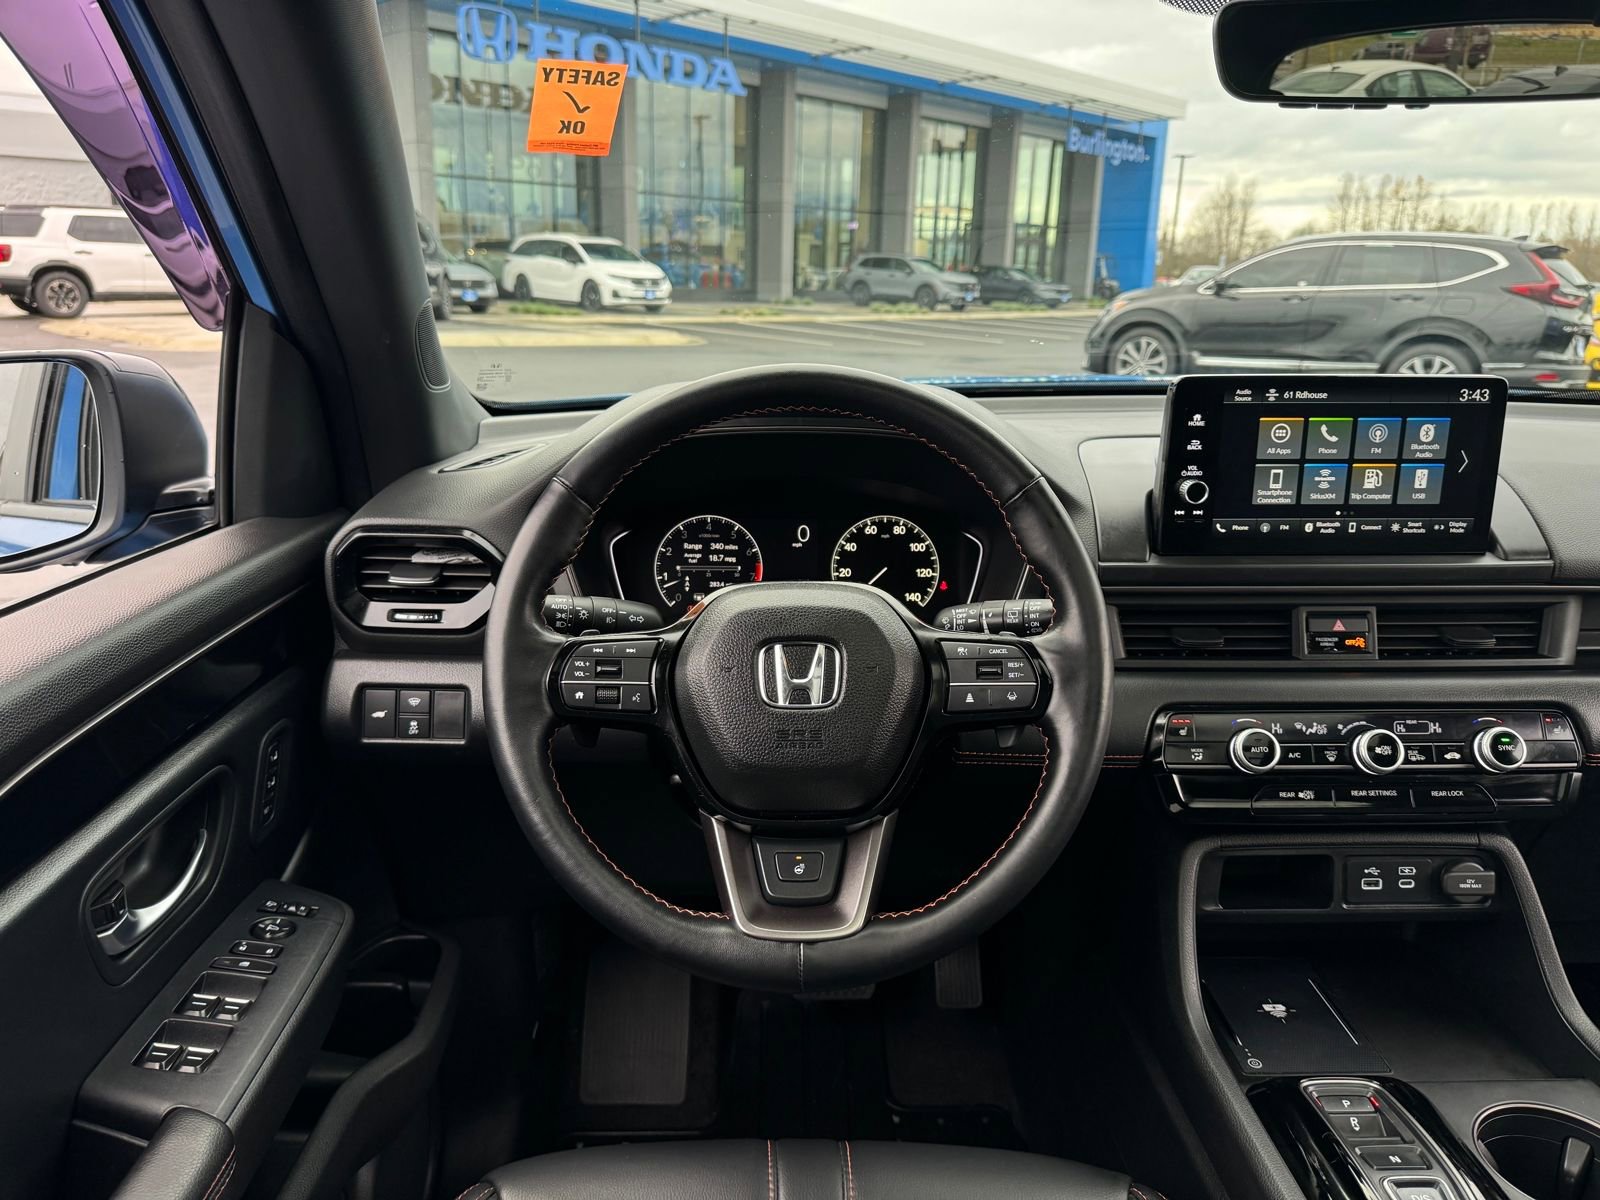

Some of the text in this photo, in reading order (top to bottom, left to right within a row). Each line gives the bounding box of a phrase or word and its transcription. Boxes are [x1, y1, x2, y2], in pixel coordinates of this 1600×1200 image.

[526, 22, 747, 96] HONDA
[1283, 391, 1328, 399] 61 Rdhouse
[1459, 388, 1490, 402] 3:43
[798, 524, 810, 542] 0
[864, 526, 877, 534] 60
[893, 526, 906, 534] 80
[731, 531, 736, 539] 5
[844, 542, 857, 552] 40
[909, 543, 926, 552] 100
[666, 548, 672, 556] 2
[663, 572, 668, 581] 1
[839, 568, 852, 577] 20
[916, 568, 933, 577] 120
[675, 593, 681, 601] 0
[905, 592, 921, 602] 140
[1342, 1099, 1350, 1108] P
[1350, 1117, 1359, 1128] R
